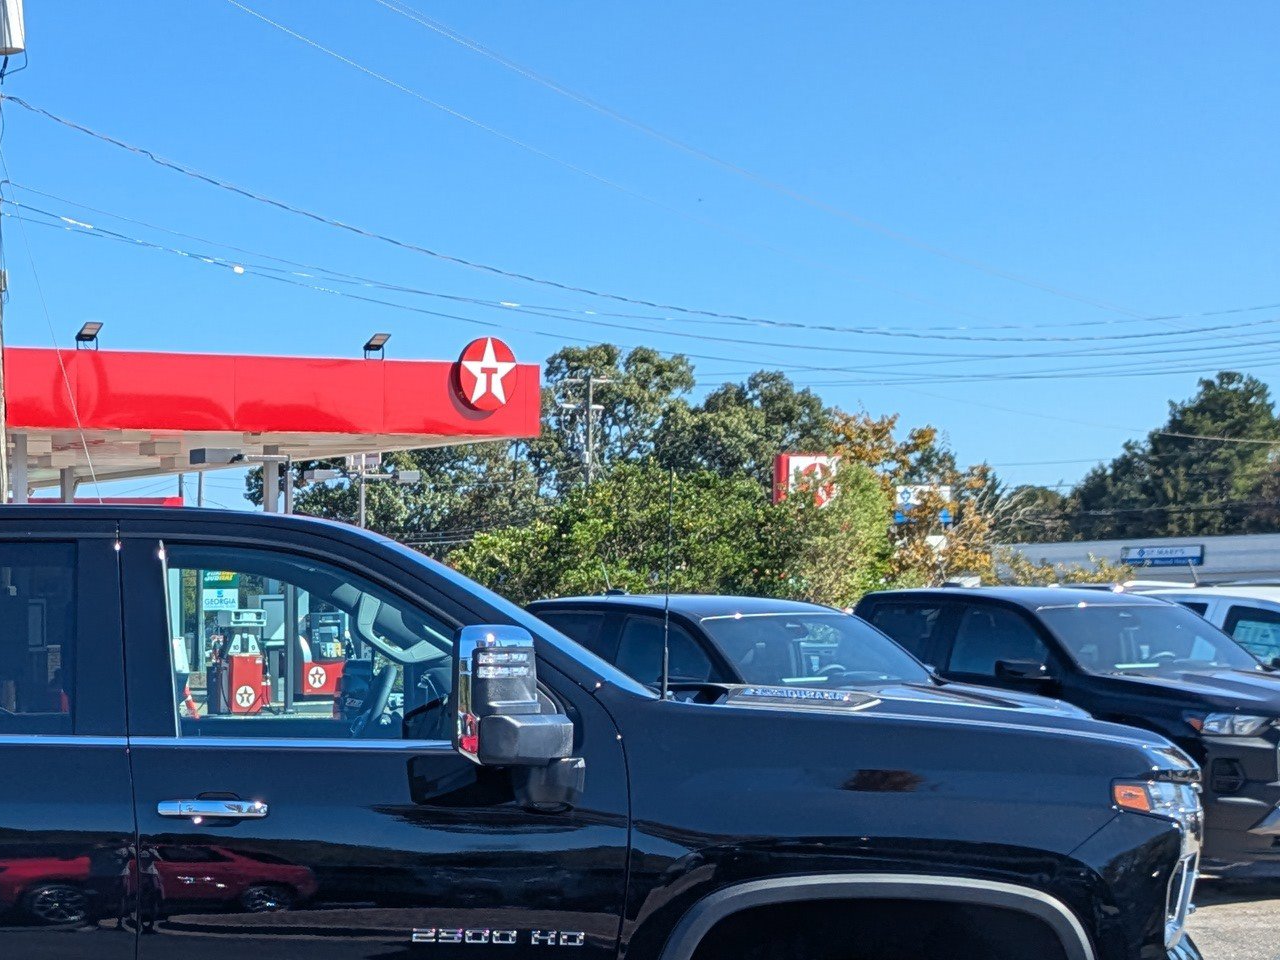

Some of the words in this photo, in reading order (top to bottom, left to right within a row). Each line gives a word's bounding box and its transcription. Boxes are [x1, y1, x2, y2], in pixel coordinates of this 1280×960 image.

[204, 598, 236, 606] GEORGIA
[412, 927, 517, 945] 2500
[531, 930, 585, 946] HD
